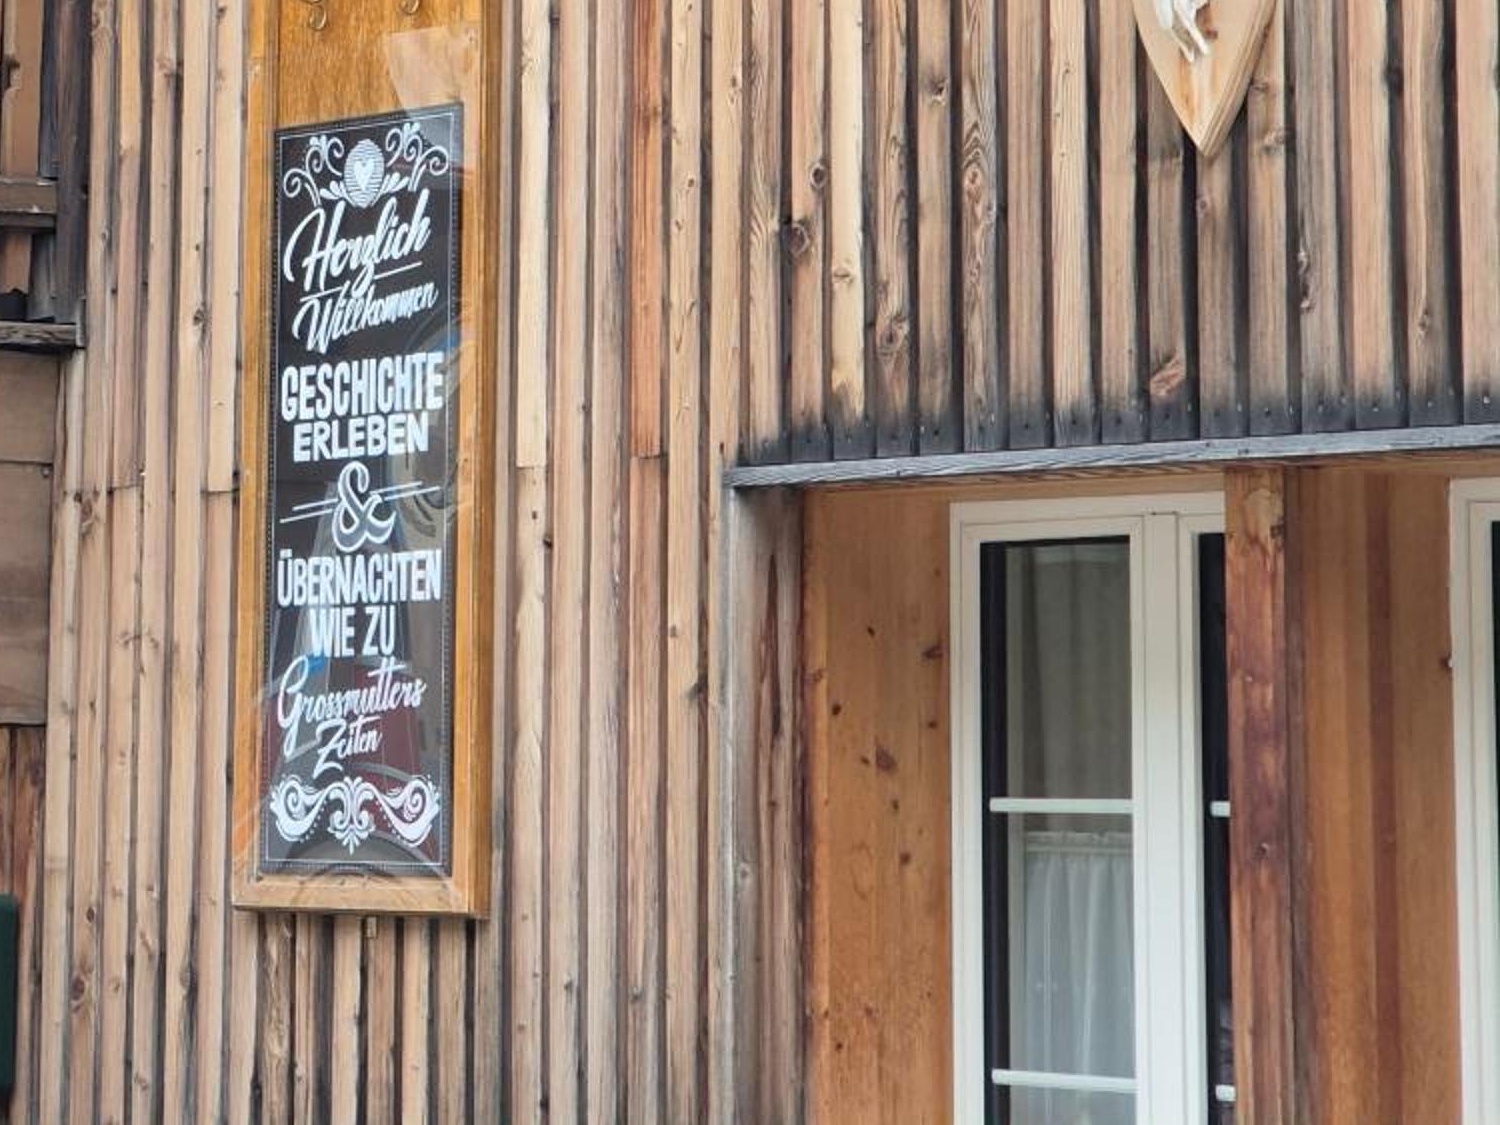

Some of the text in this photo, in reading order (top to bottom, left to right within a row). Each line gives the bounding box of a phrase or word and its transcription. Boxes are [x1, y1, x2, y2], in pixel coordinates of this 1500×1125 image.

[284, 188, 432, 295] Herzlich
[292, 281, 438, 354] Willkommen
[281, 351, 445, 423] GESCHICHTE
[292, 410, 430, 463] ERLEBEN
[332, 460, 397, 552] &
[277, 548, 442, 608] ÜBERNACHTEN
[310, 604, 396, 658] WIE ZU
[277, 655, 428, 763] Grossmutters
[312, 717, 384, 779] Zeiten
